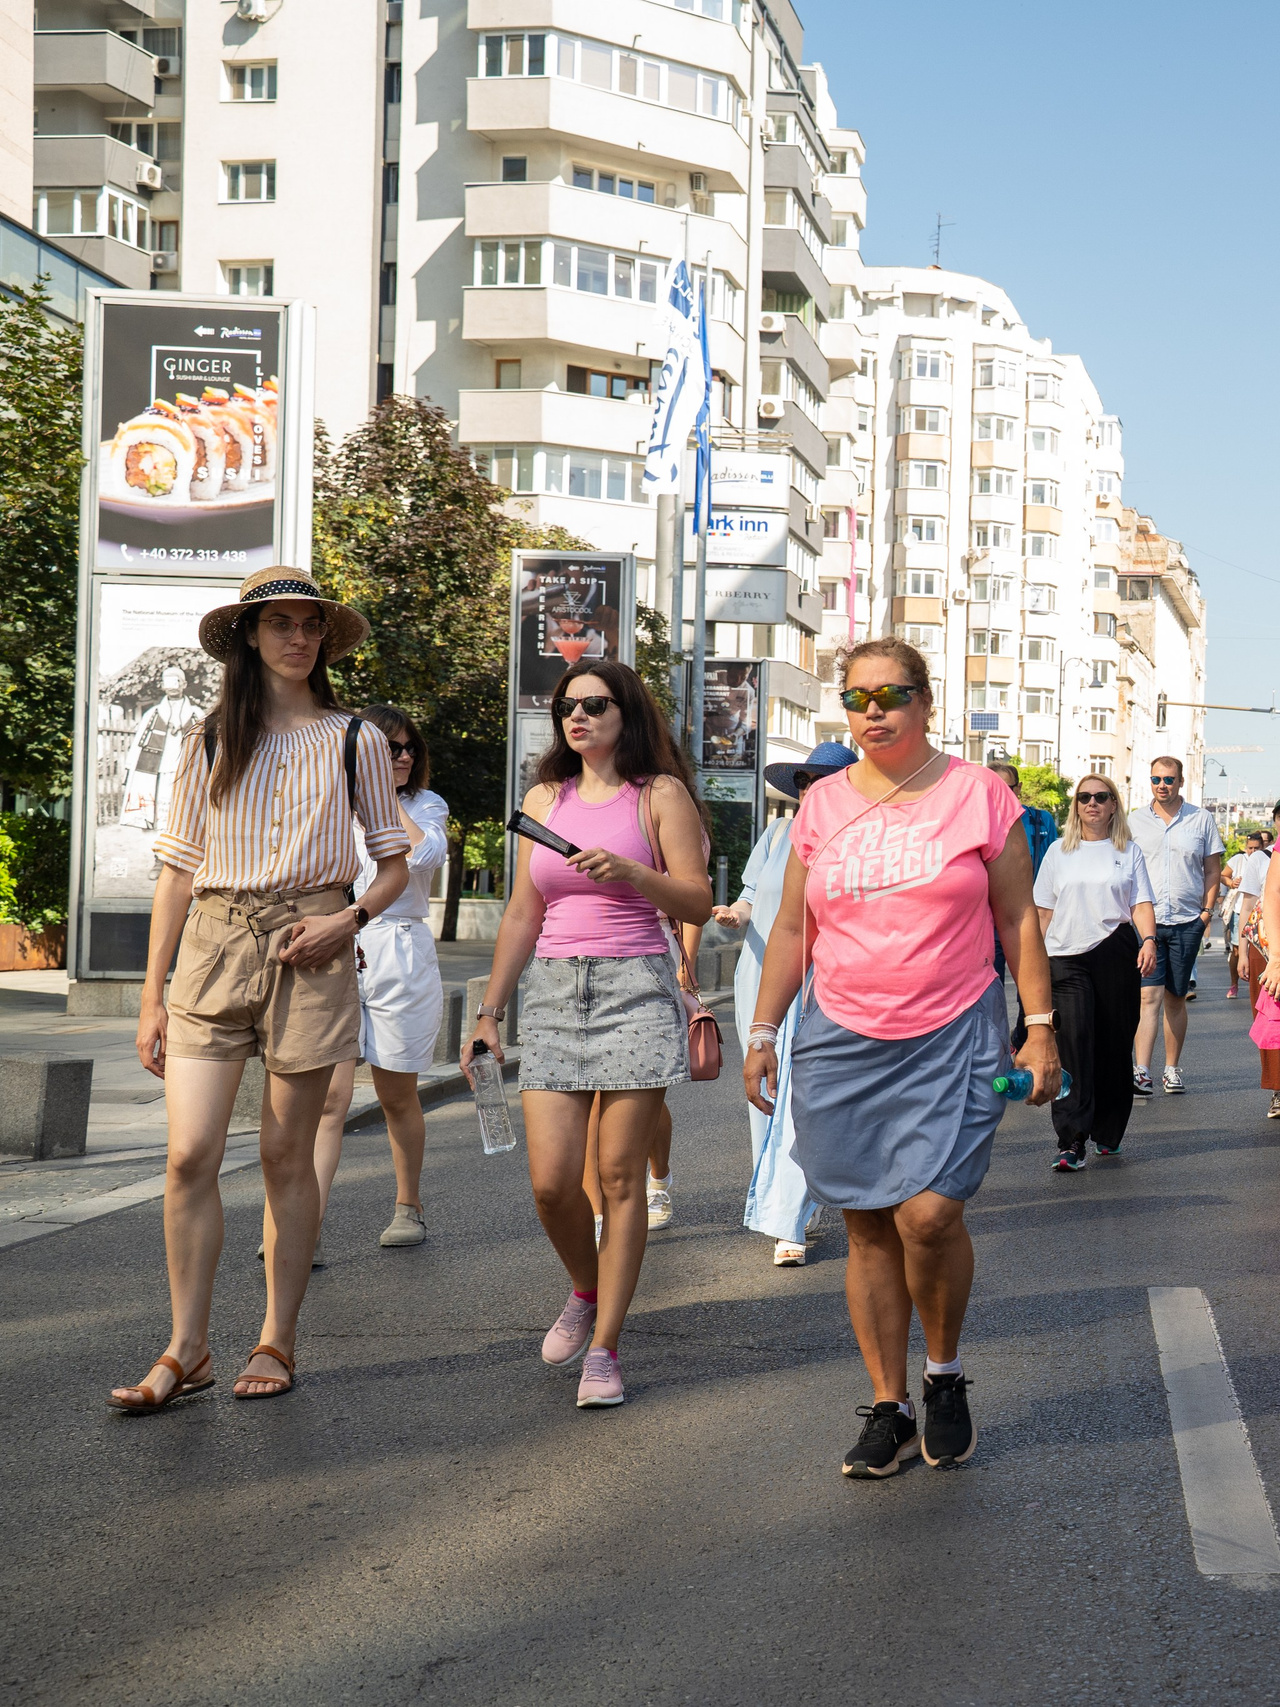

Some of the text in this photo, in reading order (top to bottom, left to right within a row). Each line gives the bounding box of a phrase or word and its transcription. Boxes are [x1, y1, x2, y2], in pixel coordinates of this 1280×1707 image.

[163, 357, 232, 375] GINGER
[706, 515, 768, 532] ark inn
[140, 548, 247, 562] +40 372 313 438
[540, 576, 566, 584] TAKE
[580, 577, 597, 585] SIP
[705, 590, 771, 600] URBERRY
[537, 586, 546, 649] REFRESH
[552, 606, 592, 614] ARISTOCOOL
[837, 817, 941, 862] FREE
